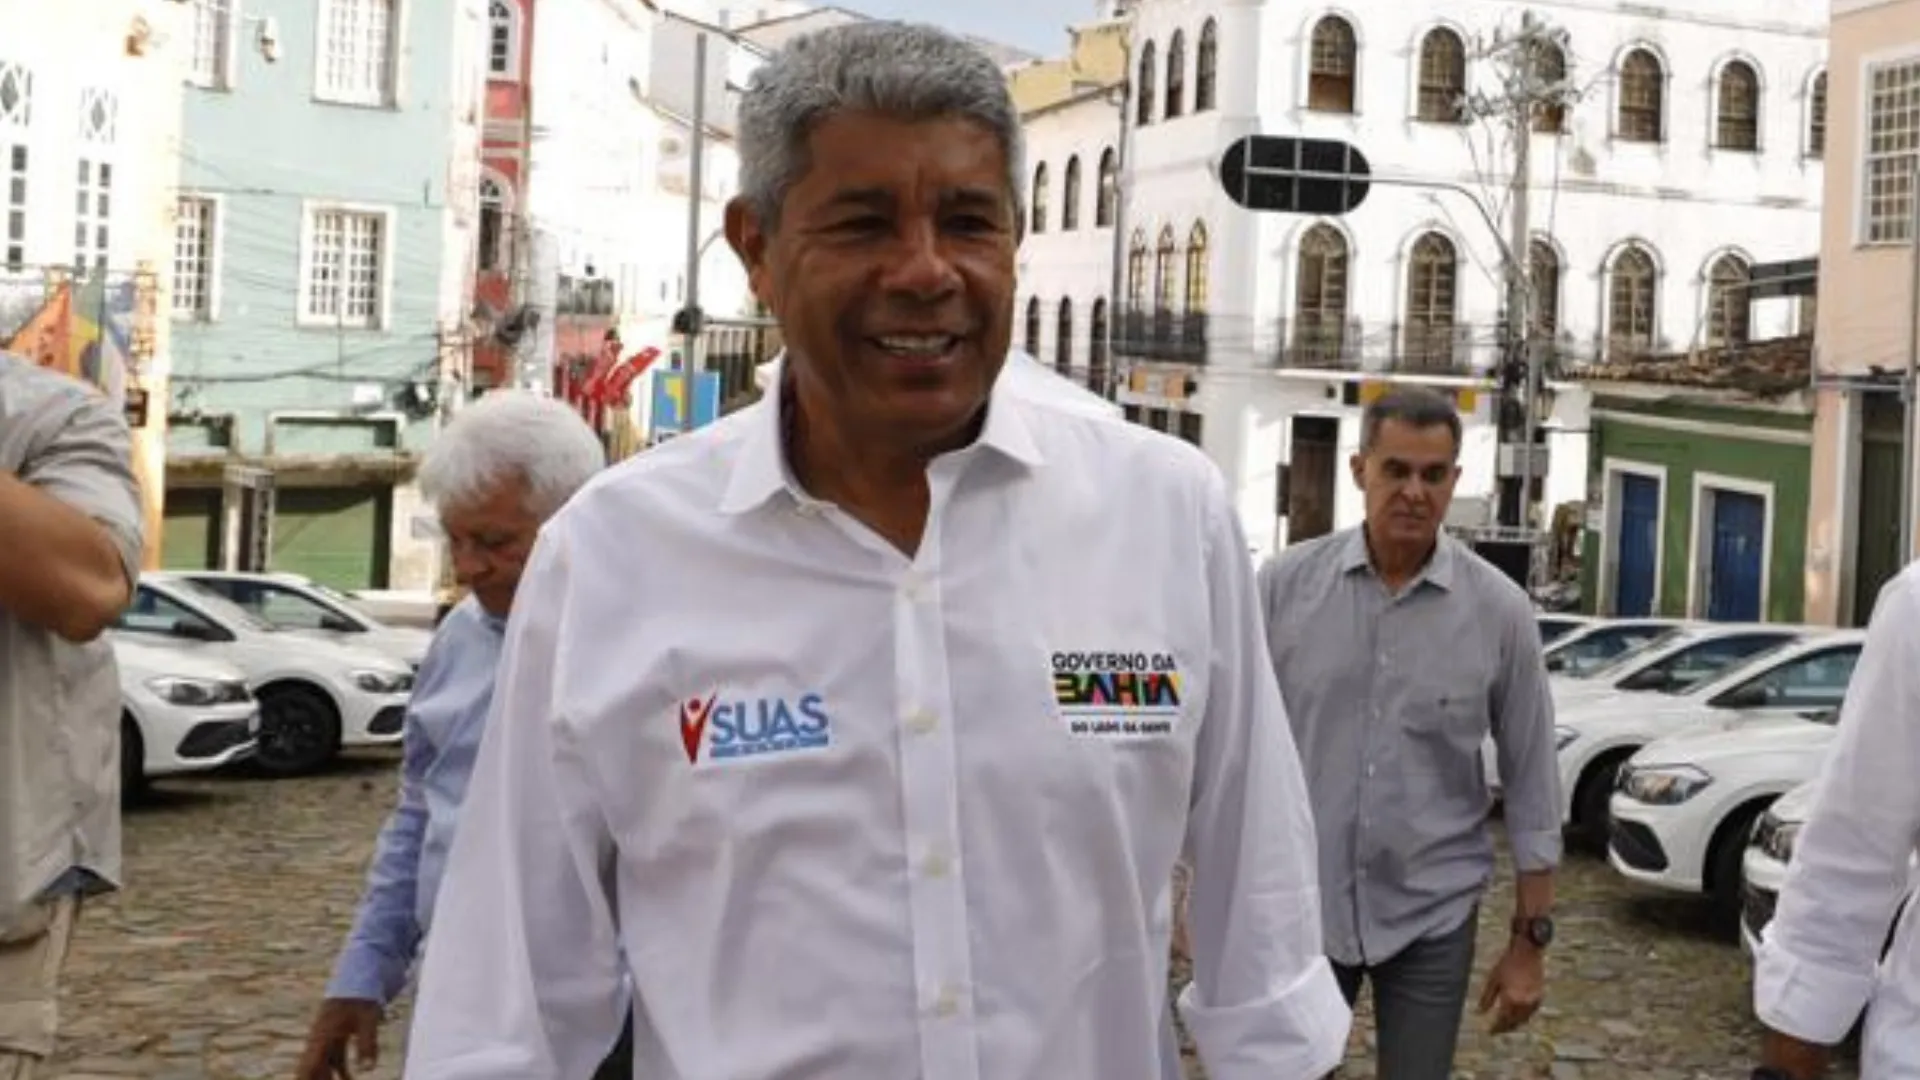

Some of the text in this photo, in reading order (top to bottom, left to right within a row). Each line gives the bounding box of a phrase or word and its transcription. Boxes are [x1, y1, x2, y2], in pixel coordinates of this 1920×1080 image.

[1052, 652, 1176, 671] GOVERNO DA
[1053, 672, 1180, 706] BAHIA
[710, 693, 829, 744] SUAS
